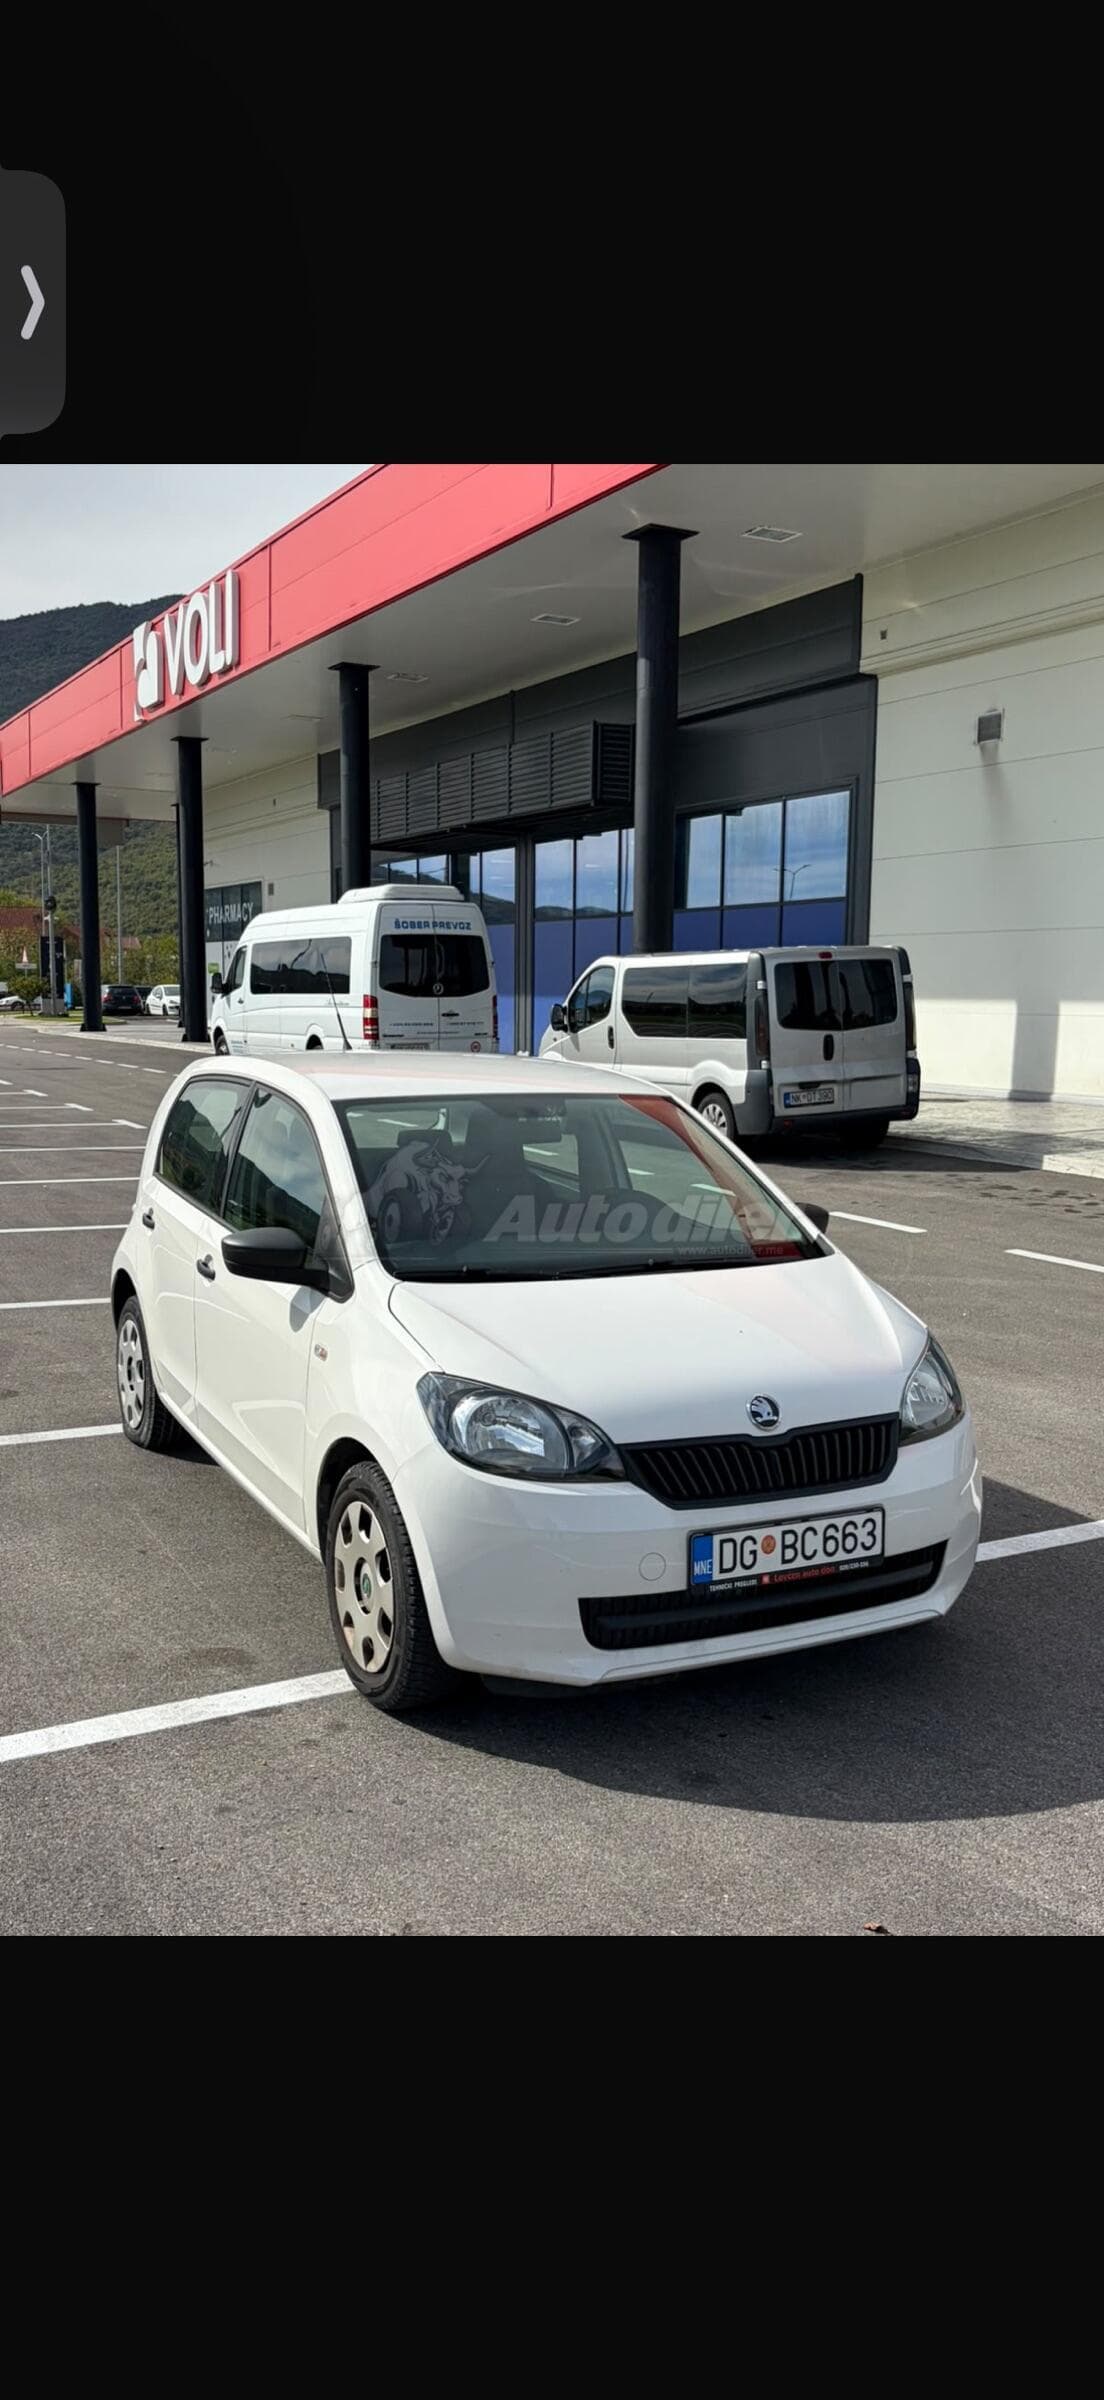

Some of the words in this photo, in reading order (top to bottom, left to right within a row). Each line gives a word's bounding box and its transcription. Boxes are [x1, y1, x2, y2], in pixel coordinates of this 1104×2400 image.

[164, 568, 238, 697] VOLI
[208, 902, 254, 925] PHARMACY
[693, 1558, 713, 1576] MNE
[719, 1535, 758, 1574] DG
